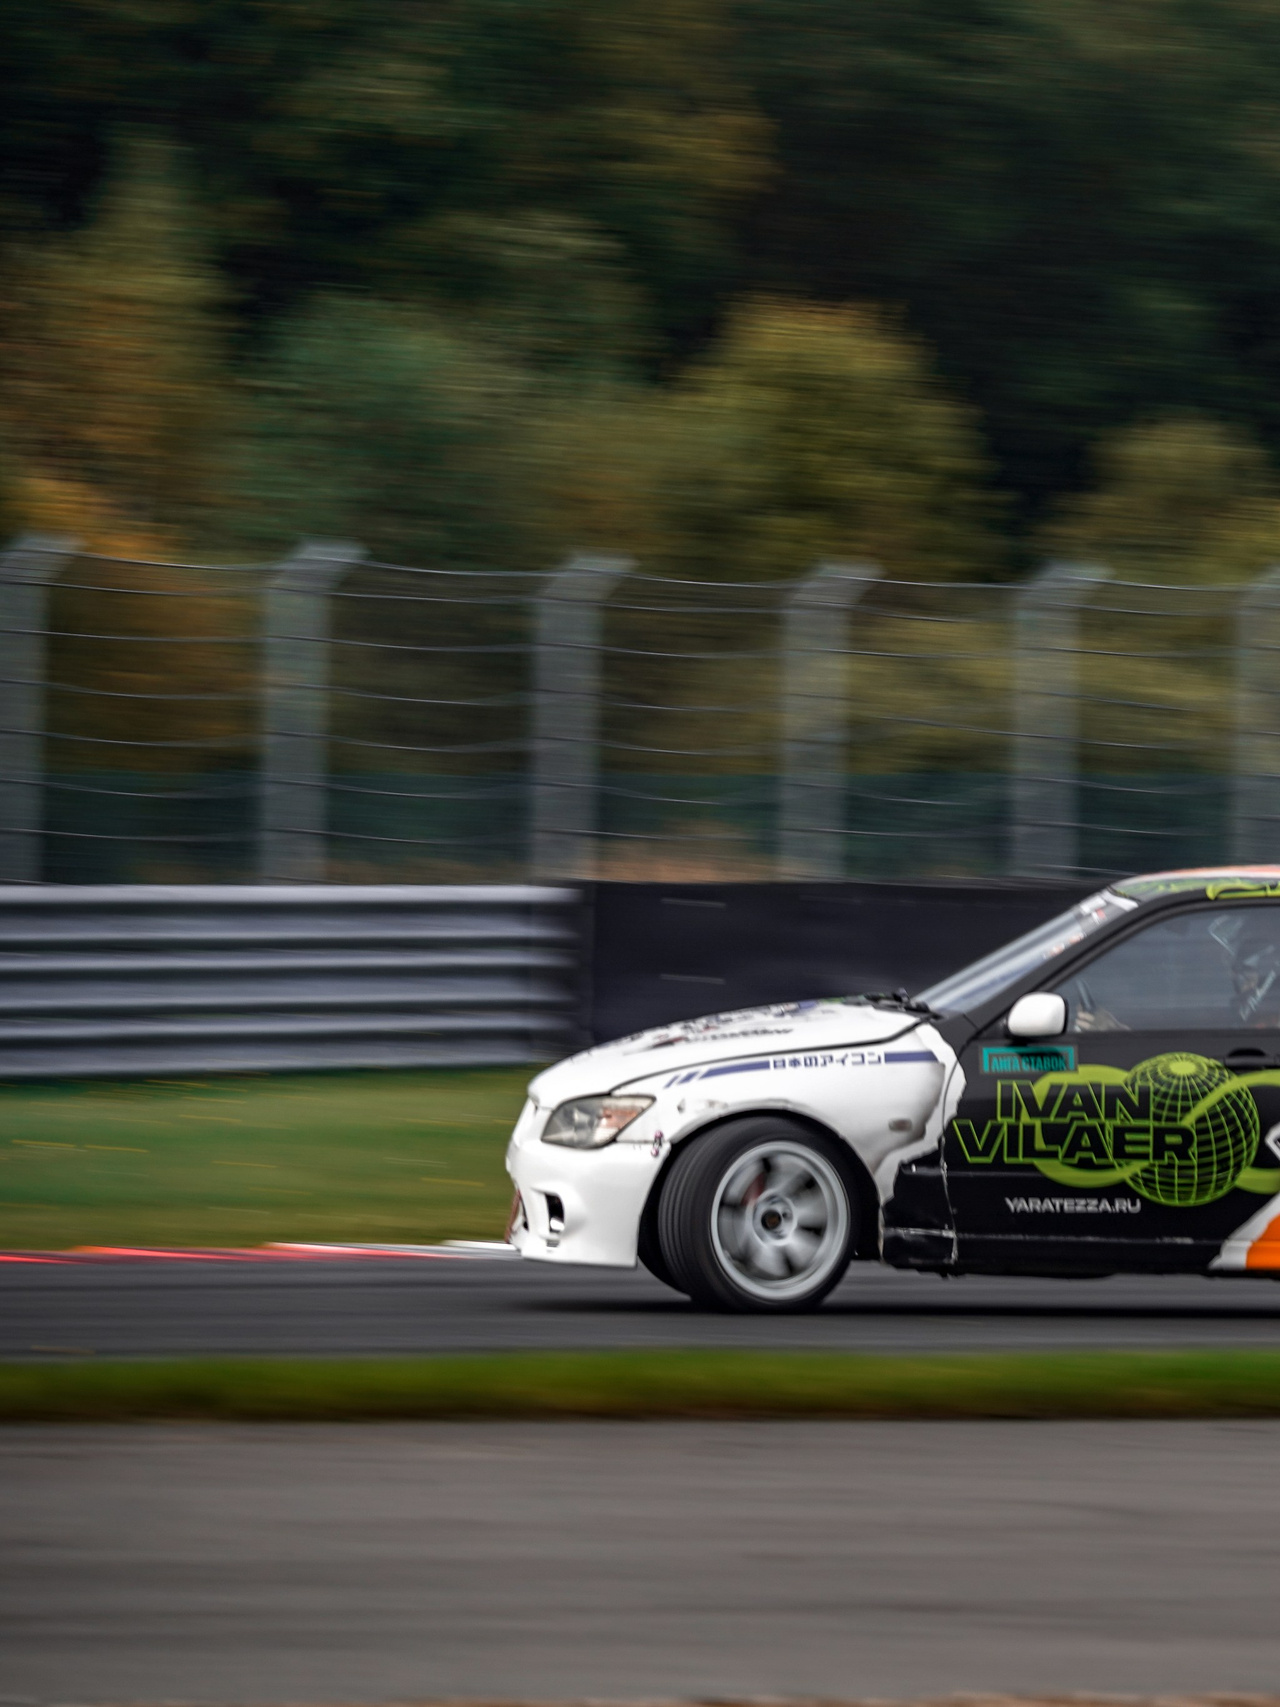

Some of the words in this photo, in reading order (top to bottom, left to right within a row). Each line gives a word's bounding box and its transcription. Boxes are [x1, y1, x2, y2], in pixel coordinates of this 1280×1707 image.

[997, 1080, 1153, 1122] IVAN
[953, 1119, 1197, 1164] VILAER
[1004, 1196, 1142, 1214] YARATEZZA.RU
